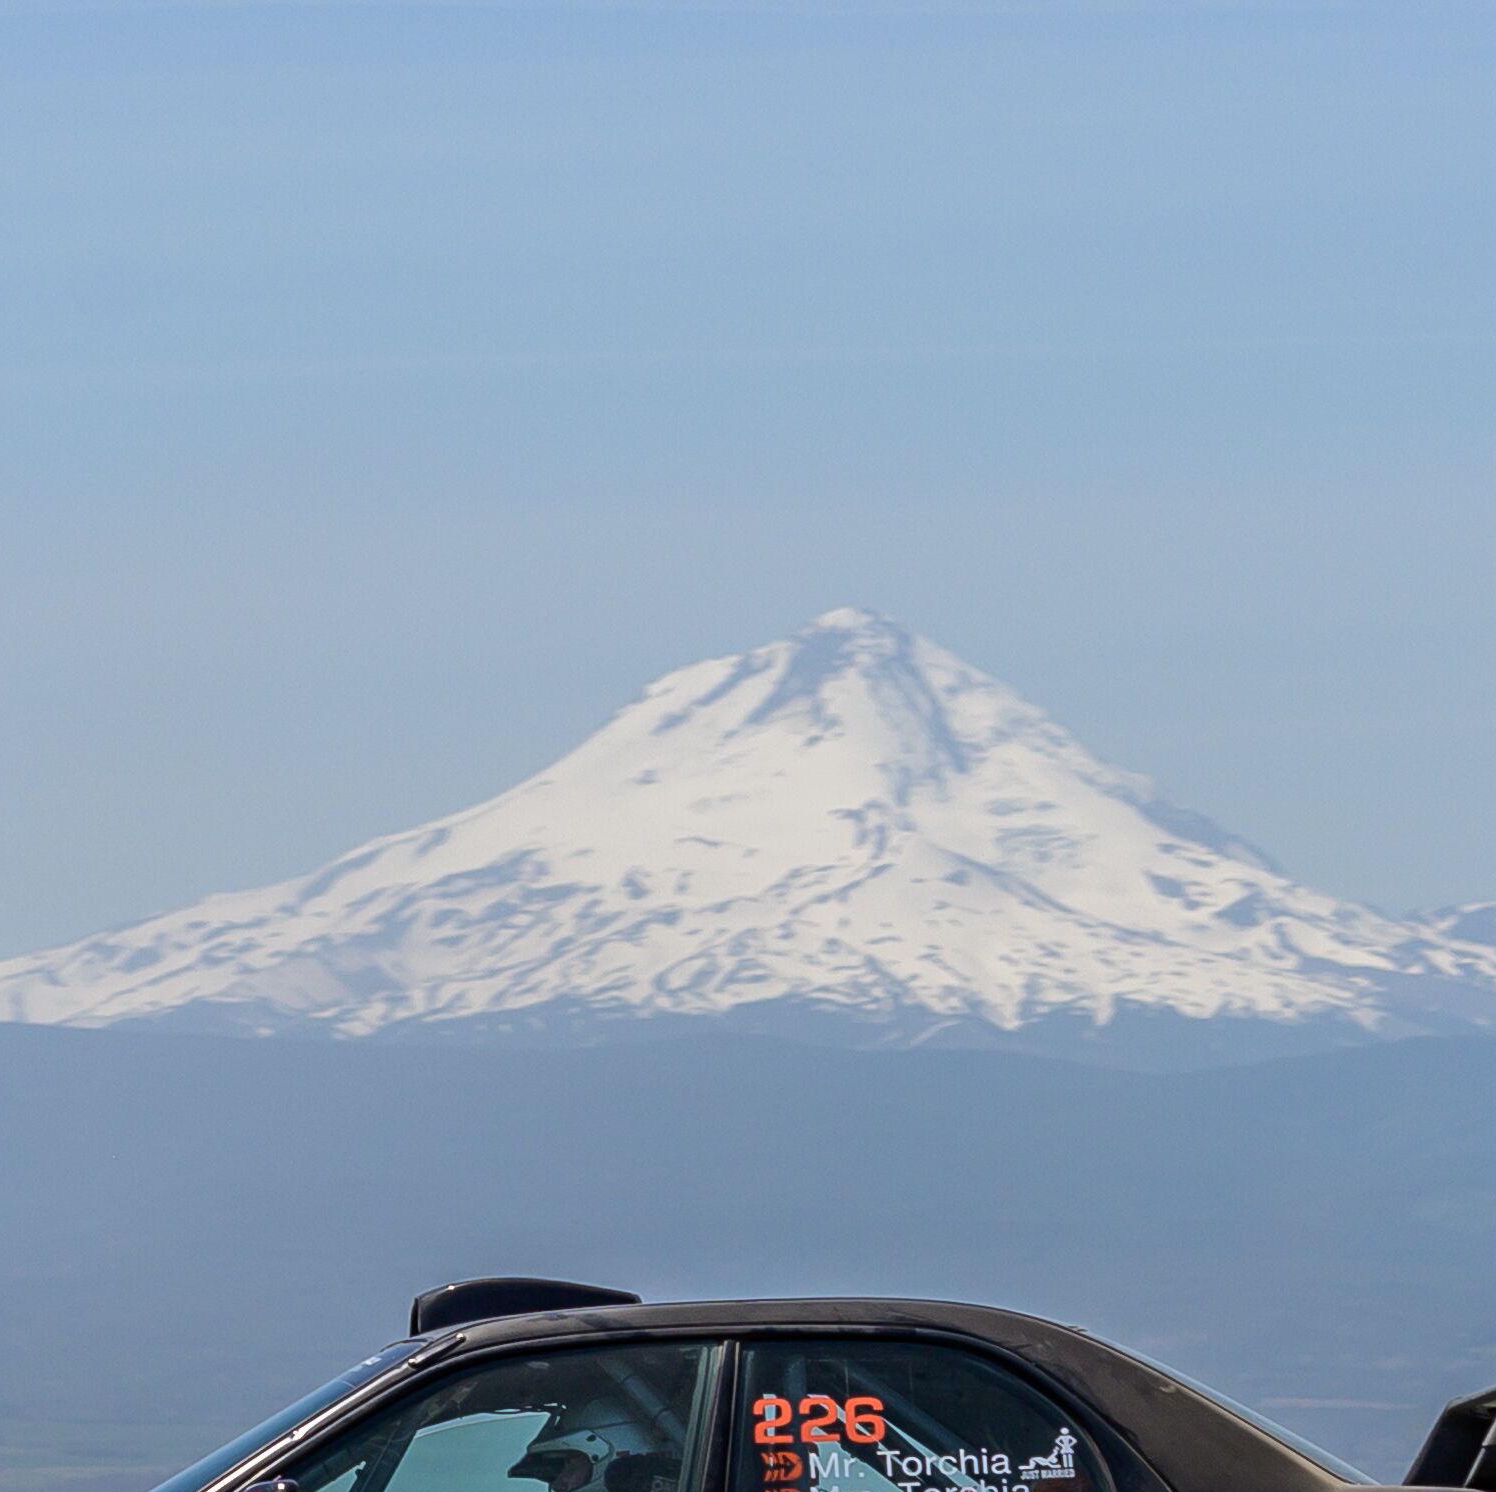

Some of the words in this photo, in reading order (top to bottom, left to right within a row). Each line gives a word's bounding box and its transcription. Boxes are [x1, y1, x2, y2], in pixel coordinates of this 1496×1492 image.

[753, 1396, 885, 1444] 226
[809, 1452, 865, 1479] Mr.
[876, 1447, 1011, 1477] Torchia
